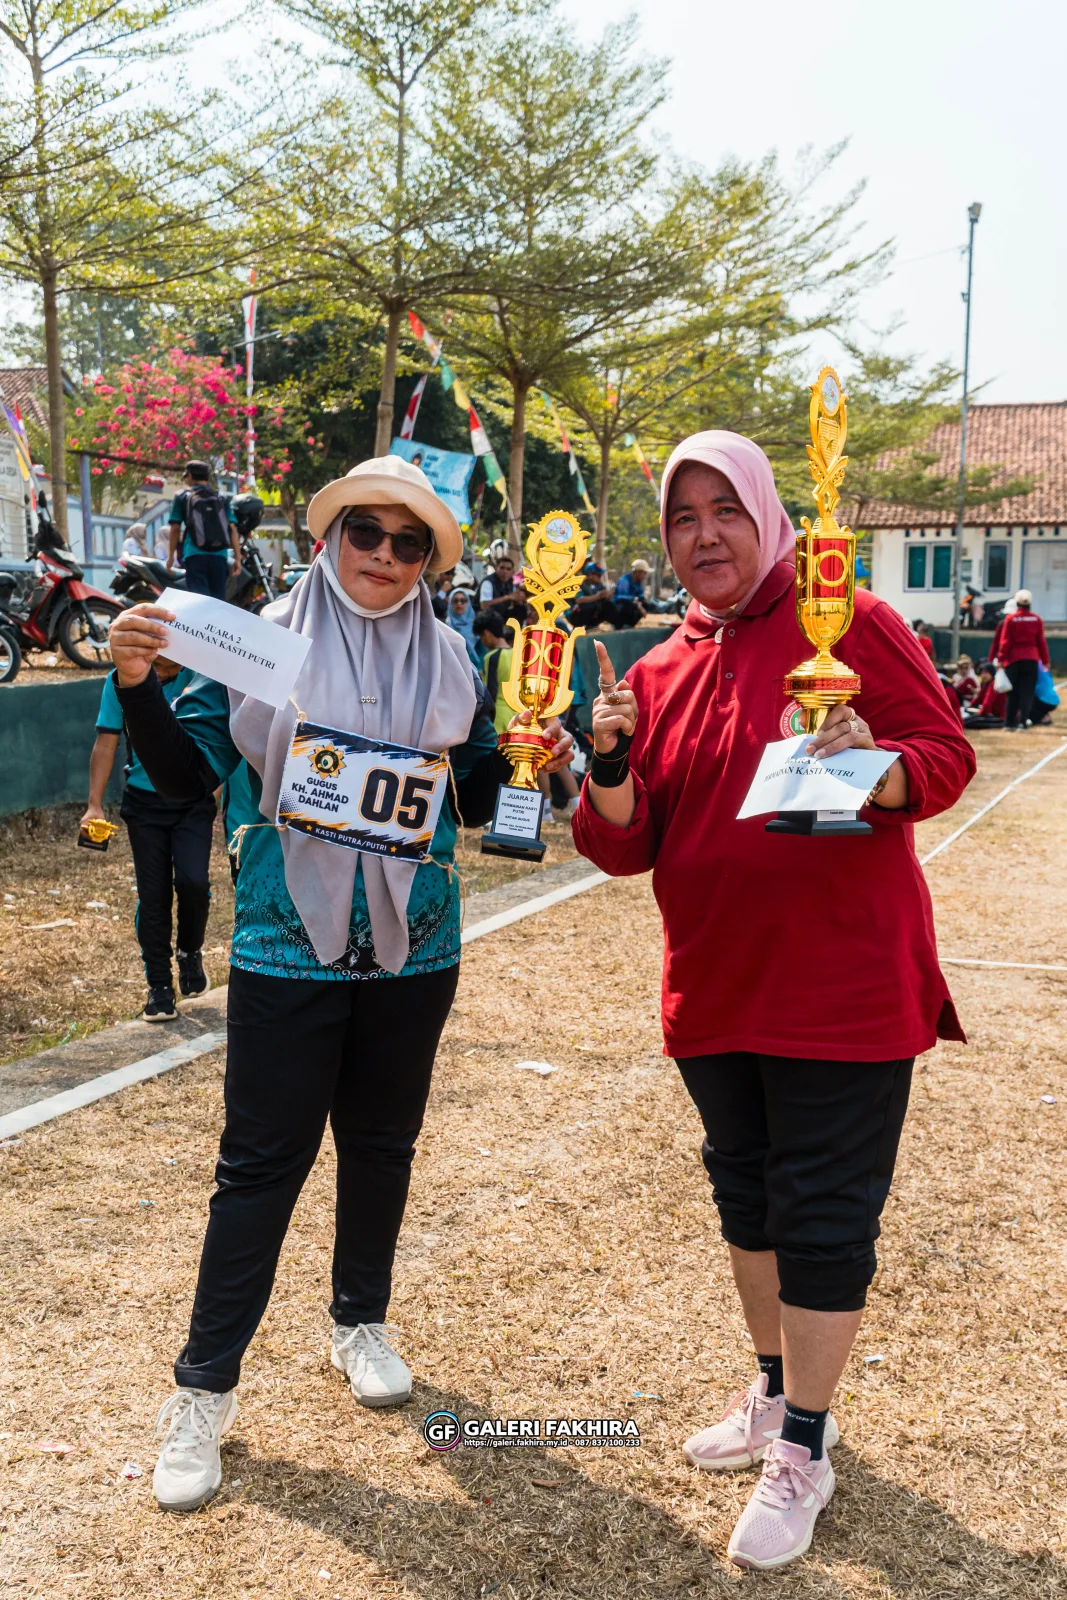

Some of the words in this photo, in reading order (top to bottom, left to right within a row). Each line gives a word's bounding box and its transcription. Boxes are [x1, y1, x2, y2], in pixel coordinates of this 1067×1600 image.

[205, 624, 233, 642] JUARA
[236, 636, 242, 644] 2
[219, 640, 247, 658] KASTI
[247, 653, 276, 670] PUTRI
[795, 766, 824, 776] KASTI
[824, 768, 855, 778] PUTRI
[291, 782, 308, 795] KH.
[311, 787, 349, 804] AHMAD
[306, 777, 338, 791] GUGUS
[298, 794, 340, 813] DAHLAN
[358, 766, 437, 832] 05
[507, 794, 528, 802] JUARA
[315, 827, 337, 839] KASTI
[337, 834, 387, 852] PUTRA/PUTRI
